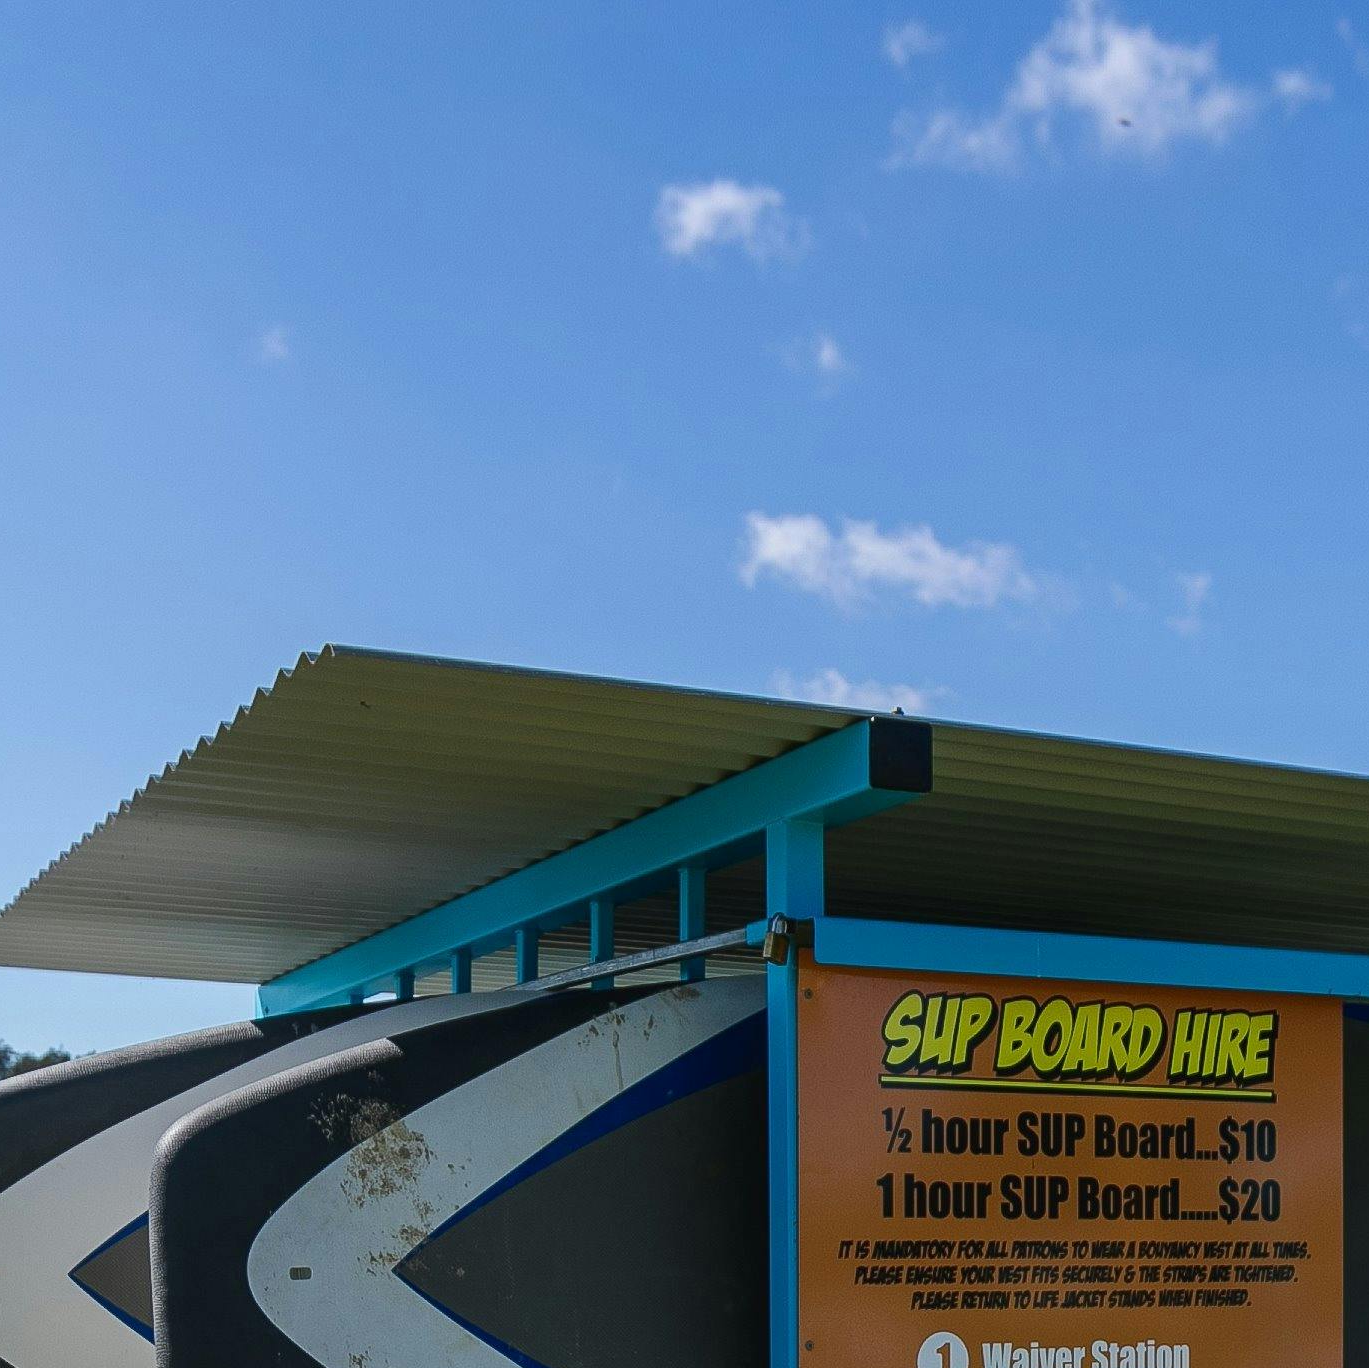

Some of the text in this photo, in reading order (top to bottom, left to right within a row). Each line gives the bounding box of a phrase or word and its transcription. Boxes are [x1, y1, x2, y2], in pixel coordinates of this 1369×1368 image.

[882, 990, 1278, 1087] SUP BOARD HIRE
[921, 1108, 1010, 1156] hour
[1017, 1111, 1086, 1158] SUP
[876, 1172, 894, 1219] 1
[903, 1173, 993, 1219] hour
[1000, 1174, 1070, 1221] SUP
[837, 1239, 853, 1259] IT
[854, 1239, 871, 1259] IS
[871, 1239, 956, 1260] MANDATORY
[956, 1240, 985, 1260] FOR
[984, 1240, 1008, 1259] ALL
[1011, 1240, 1069, 1260] PATRONS
[1071, 1240, 1090, 1259] TO
[1090, 1240, 1126, 1260] WEAR
[1124, 1240, 1137, 1260] A
[1202, 1241, 1233, 1260] VEST
[1231, 1241, 1250, 1260] AT
[1248, 1241, 1272, 1260] ALL
[1271, 1241, 1312, 1260] TIMES.
[854, 1265, 904, 1285] PLEASE
[904, 1265, 959, 1285] ENSURE
[960, 1265, 997, 1284] YOUR
[997, 1265, 1031, 1285] VEST
[1030, 1265, 1061, 1285] FITS
[1061, 1265, 1123, 1284] SECURELY
[1138, 1265, 1162, 1283] THE
[1162, 1265, 1209, 1284] STRAPS
[1207, 1265, 1233, 1284] ARE
[1233, 1265, 1299, 1284] TIGHTENED.
[911, 1289, 1253, 1311] PLEASE RETURN TO LIFE JACKET STANDS WHEN FINISHED.
